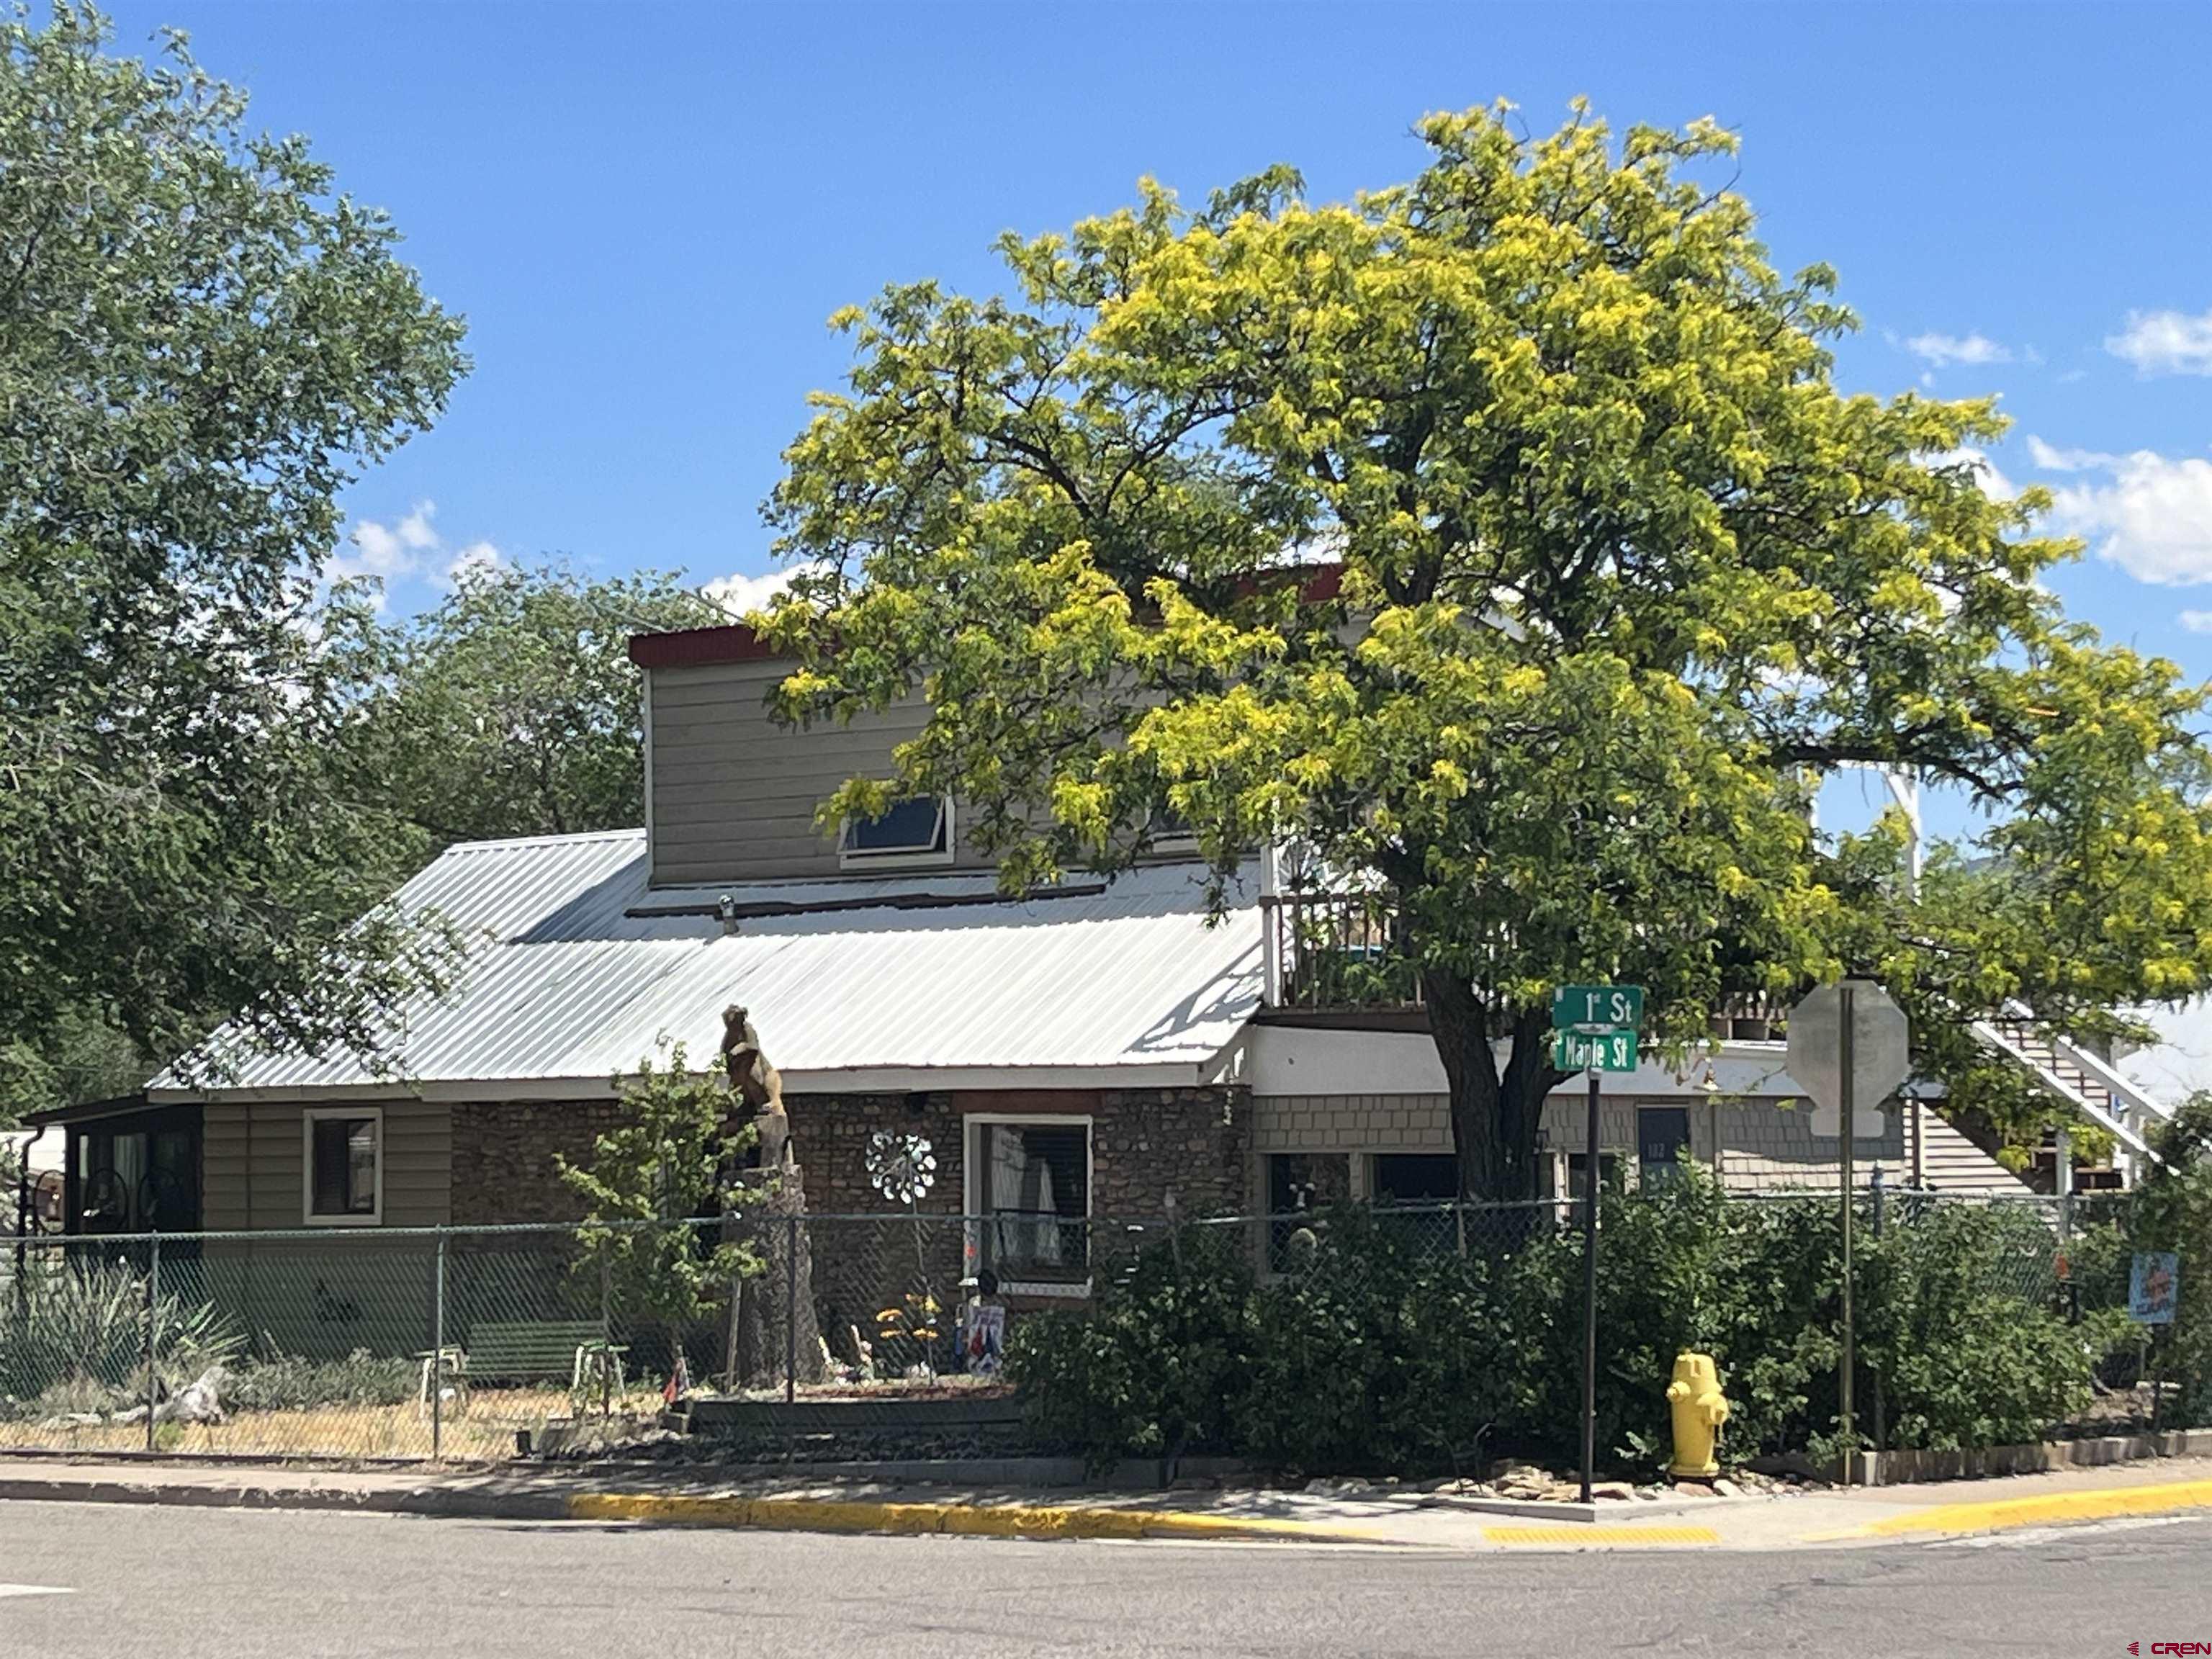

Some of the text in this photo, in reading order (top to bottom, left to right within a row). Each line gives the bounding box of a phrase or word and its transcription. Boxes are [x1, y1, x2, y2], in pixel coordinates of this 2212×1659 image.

[1610, 993, 1632, 1023] St
[1565, 1035, 1628, 1071] Maple St
